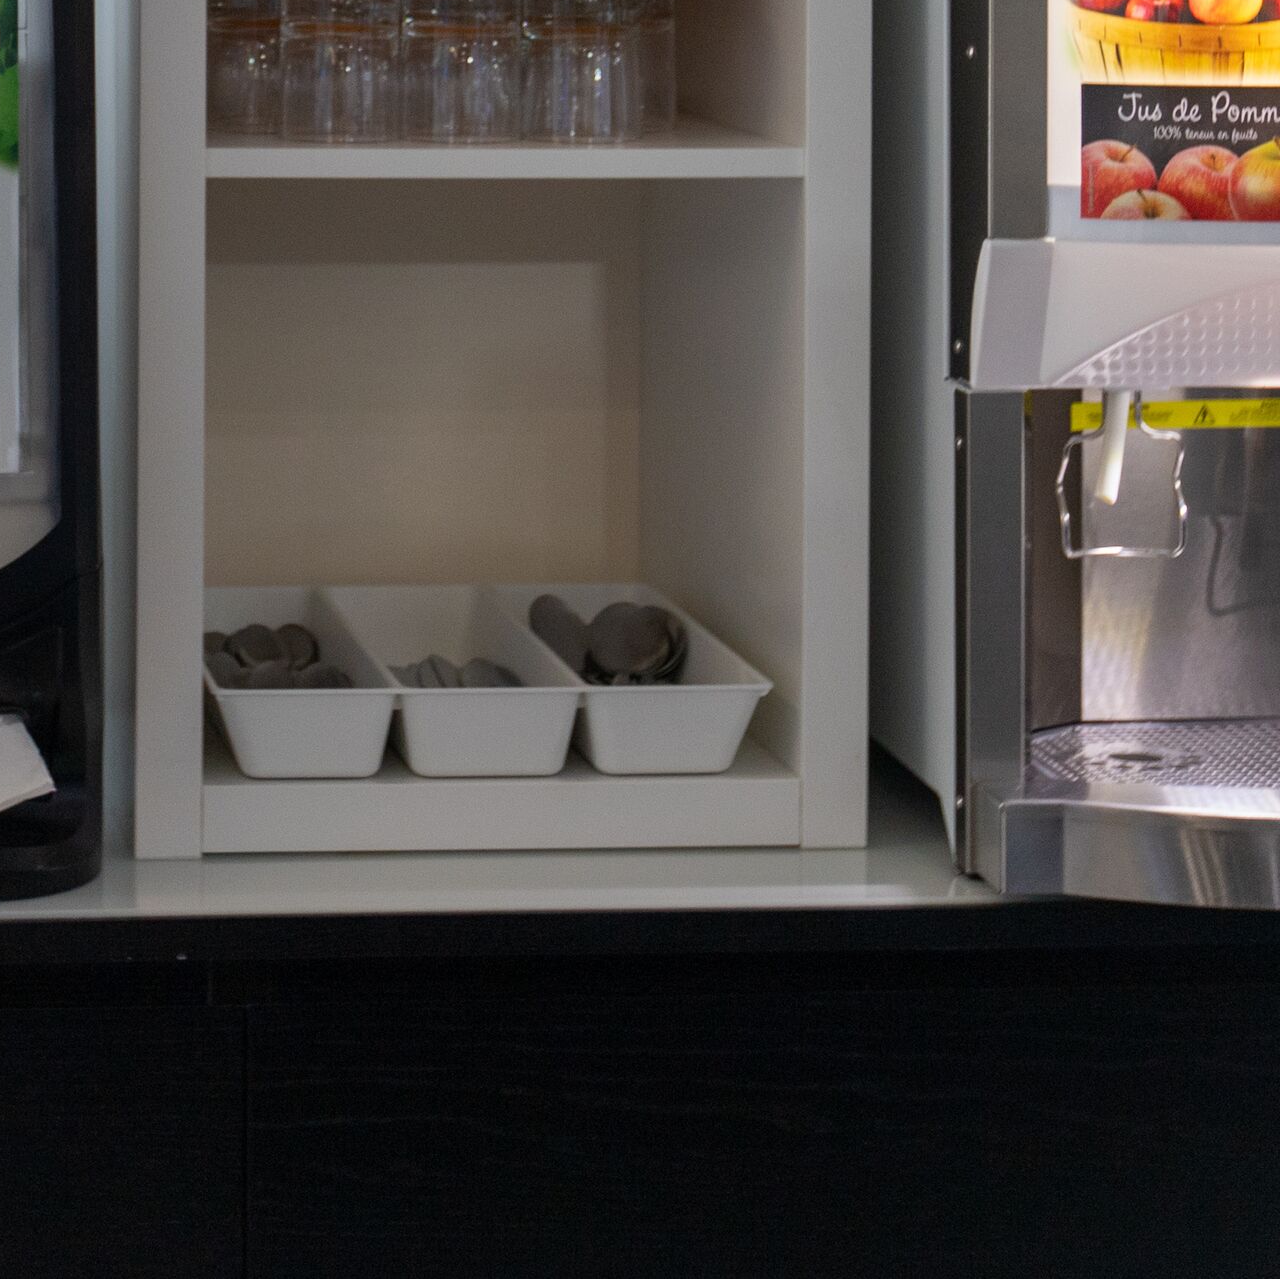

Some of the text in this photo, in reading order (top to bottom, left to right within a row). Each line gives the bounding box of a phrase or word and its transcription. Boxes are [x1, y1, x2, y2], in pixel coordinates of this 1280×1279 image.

[1118, 92, 1162, 122] Jus
[1173, 98, 1201, 122] de
[1154, 125, 1181, 140] 100%
[1218, 130, 1229, 140] en
[1231, 126, 1258, 145] fruits
